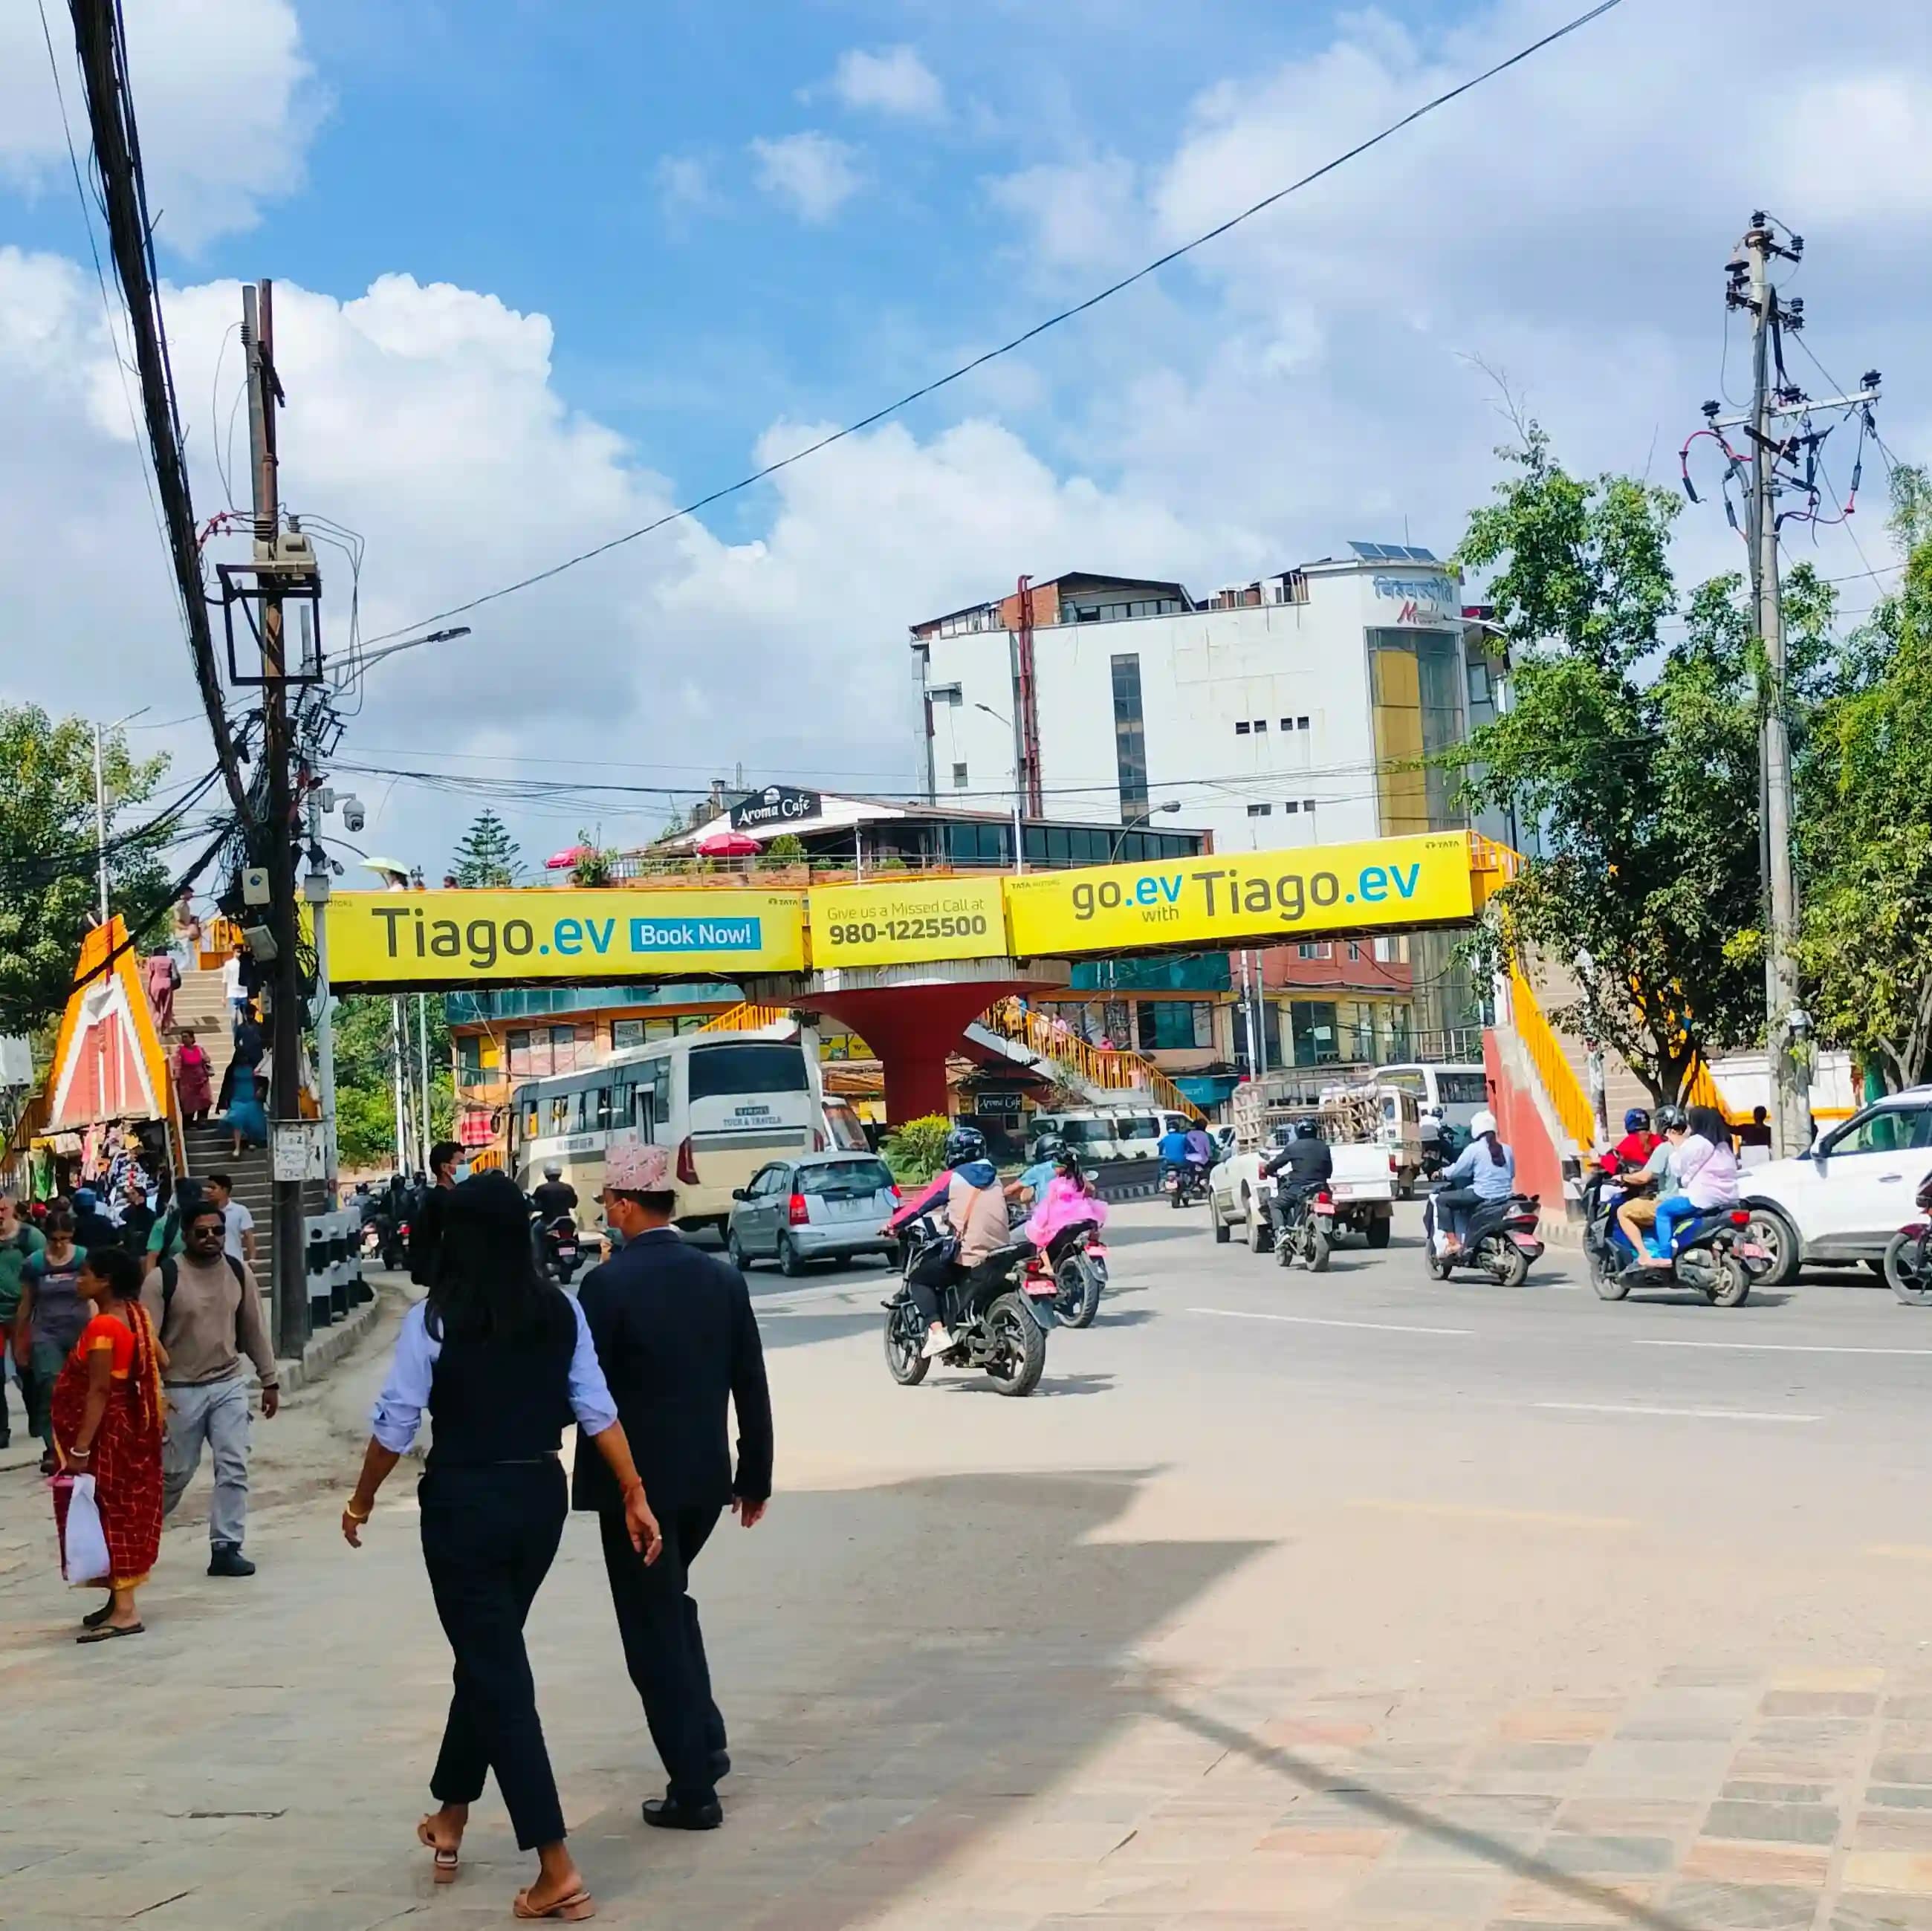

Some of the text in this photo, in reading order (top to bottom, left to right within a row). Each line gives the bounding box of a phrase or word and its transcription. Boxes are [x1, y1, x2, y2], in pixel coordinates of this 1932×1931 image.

[737, 805, 779, 827] Aroma
[1438, 840, 1460, 848] TATA
[1072, 863, 1420, 921] go.ev Tiago.ev
[827, 898, 985, 921] Give us a Missed Call at
[1141, 905, 1180, 923] with
[372, 907, 751, 968] Tiago.ev Book Now!
[829, 915, 987, 945] 980-1225500
